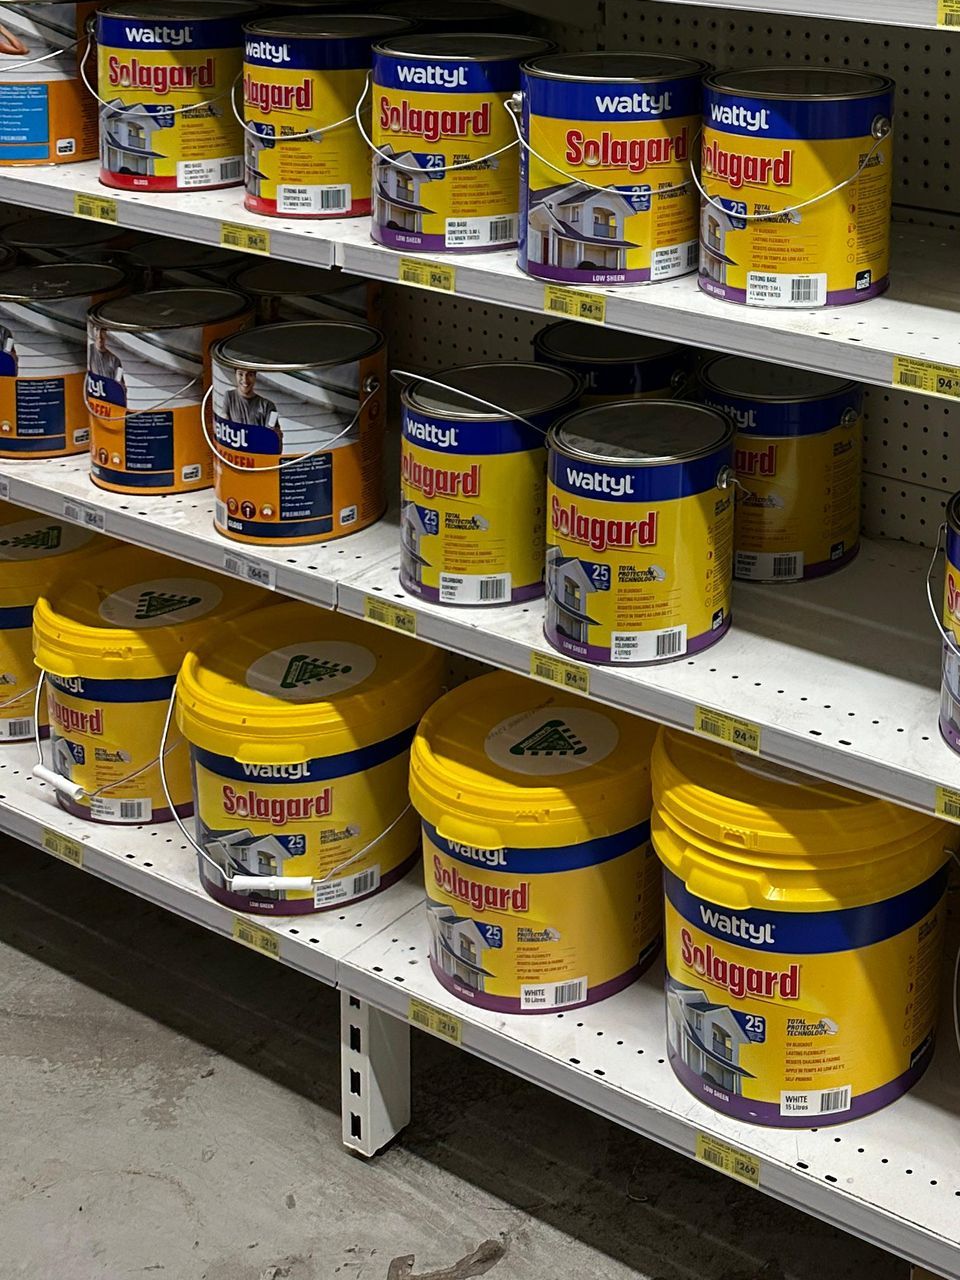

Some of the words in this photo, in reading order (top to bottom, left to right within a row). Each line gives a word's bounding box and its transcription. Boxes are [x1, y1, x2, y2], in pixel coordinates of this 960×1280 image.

[125, 26, 191, 44] wattyl
[109, 56, 216, 95] Solagard
[397, 65, 467, 88] wattyl
[380, 96, 491, 142] Solagard
[595, 92, 671, 115] wattyl
[710, 102, 768, 131] wattyl
[566, 127, 689, 173] Solagard
[593, 273, 605, 283] LOW
[606, 273, 626, 283] SHEEN
[406, 417, 458, 448] wattyl
[566, 467, 634, 496] wattyl
[551, 494, 657, 552] Solagard
[223, 785, 333, 827] Solagard
[433, 854, 530, 912] Solagard
[700, 904, 774, 945] wattyl
[680, 926, 802, 1000] Solagard
[524, 988, 546, 998] WHITE
[785, 1094, 808, 1104] WHITE
